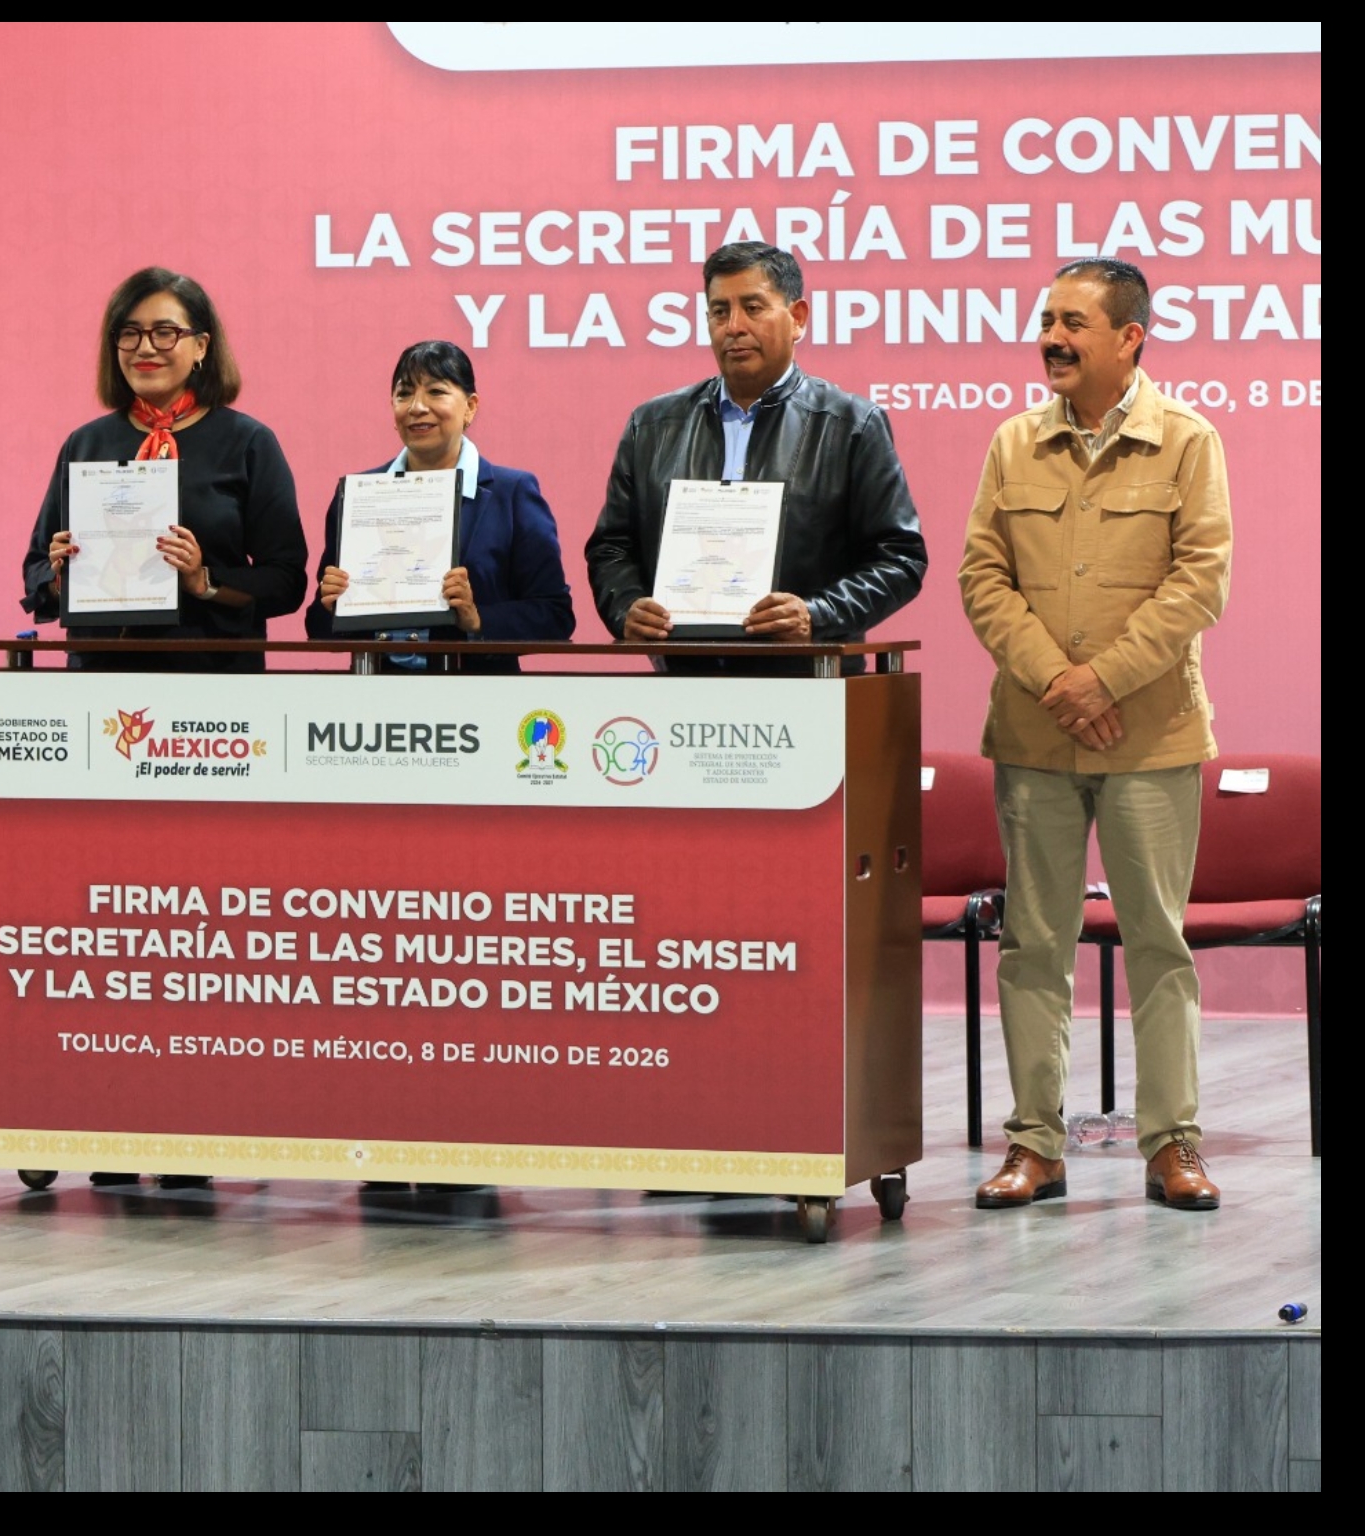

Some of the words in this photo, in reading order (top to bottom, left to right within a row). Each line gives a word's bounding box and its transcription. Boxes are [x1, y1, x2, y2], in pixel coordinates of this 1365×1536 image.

[615, 122, 854, 181] FIRMA
[878, 119, 978, 176] DE
[1002, 113, 1321, 175] CONVEN
[315, 212, 410, 268] LA
[430, 191, 906, 267] SECRETARÍA
[930, 203, 1030, 259] DE
[1056, 199, 1204, 259] LAS
[455, 293, 506, 349] Y
[528, 292, 626, 348] LA
[799, 287, 1047, 346] IPINN
[1150, 283, 1321, 342] STA
[869, 381, 1013, 411] ESTADO
[1025, 381, 1053, 409] D
[1154, 379, 1237, 413] ICO,
[1248, 379, 1269, 408] 8
[49, 718, 68, 728] DEL
[51, 731, 68, 743] DE
[170, 720, 227, 734] ESTADO
[230, 721, 250, 734] DE
[308, 722, 480, 754] MUJERES
[669, 722, 795, 749] SIPINNA
[147, 735, 250, 759] MÉXICO
[305, 754, 369, 766] SECRETARÍA
[371, 756, 386, 766] DE
[388, 756, 409, 767] LAS
[411, 756, 460, 768] MUJERES
[135, 762, 152, 778] ¡El
[154, 762, 190, 778] poder
[192, 762, 209, 776] de
[211, 762, 250, 777] servir!
[89, 884, 209, 916] FIRMA
[221, 887, 271, 917] DE
[282, 887, 492, 922] CONVENIO
[505, 892, 635, 924] ENTRE
[247, 930, 297, 961] DE
[309, 931, 383, 963] LAS
[395, 934, 585, 973] MUJERES,
[599, 938, 645, 969] EL
[656, 938, 797, 972] SMSEM
[8, 968, 34, 998] Y
[46, 969, 95, 999] LA
[105, 970, 151, 1001] SE
[162, 971, 320, 1005] SIPINNA
[333, 975, 488, 1009] ESTADO
[501, 979, 552, 1011] DE
[565, 974, 719, 1015] MÉXICO
[57, 1032, 160, 1058] TOLUCA,
[169, 1035, 264, 1057] ESTADO
[273, 1038, 305, 1058] DE
[313, 1034, 412, 1065] MÉXICO,
[421, 1041, 435, 1062] 8
[443, 1042, 476, 1063] DE
[483, 1043, 559, 1065] JUNIO
[567, 1045, 600, 1066] DE
[608, 1047, 670, 1068] 2026
